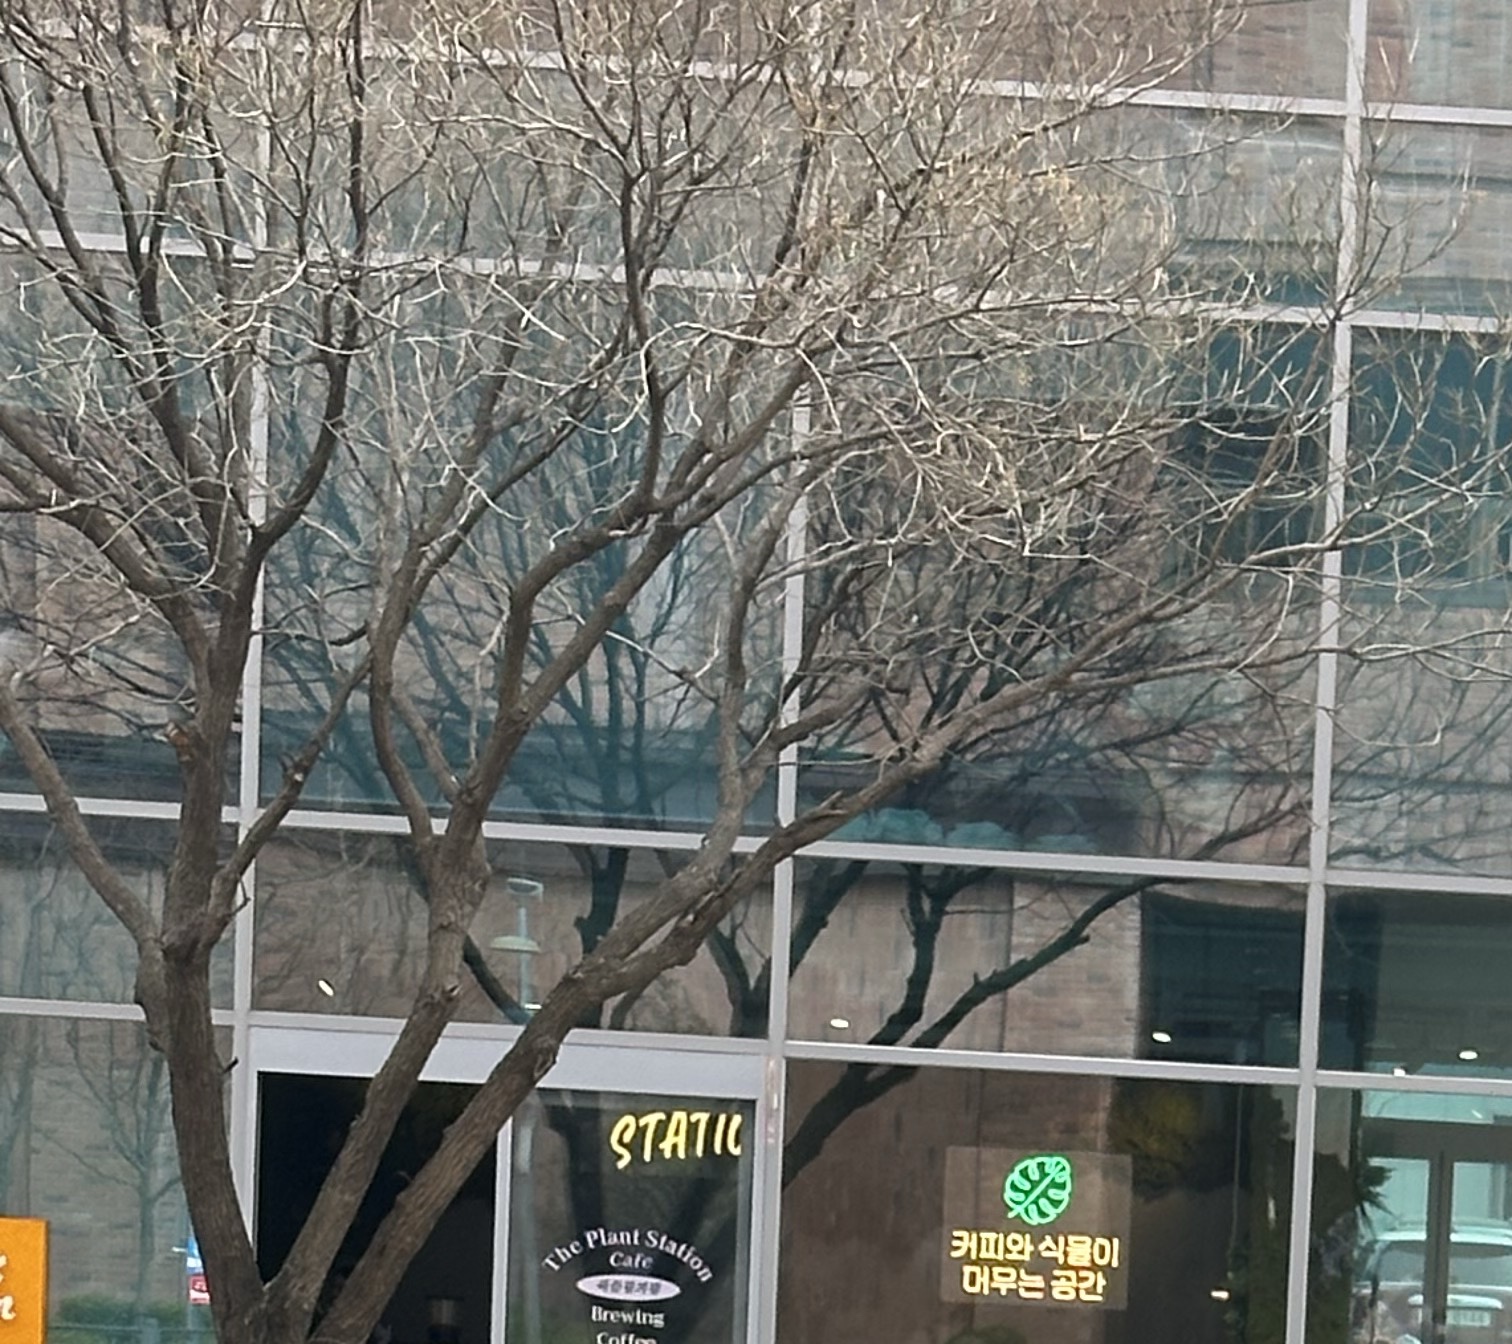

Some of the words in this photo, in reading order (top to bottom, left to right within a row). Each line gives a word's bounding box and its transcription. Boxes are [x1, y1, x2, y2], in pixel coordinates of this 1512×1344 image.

[541, 1240, 584, 1272] The
[585, 1227, 640, 1250] Plant
[644, 1229, 713, 1283] Station
[609, 1251, 654, 1270] Cafe
[949, 1230, 1035, 1262] 커피와
[1038, 1233, 1120, 1268] 식물이
[962, 1264, 1045, 1300] 머무는
[1050, 1268, 1107, 1302] 공간
[591, 1305, 665, 1329] Brewing
